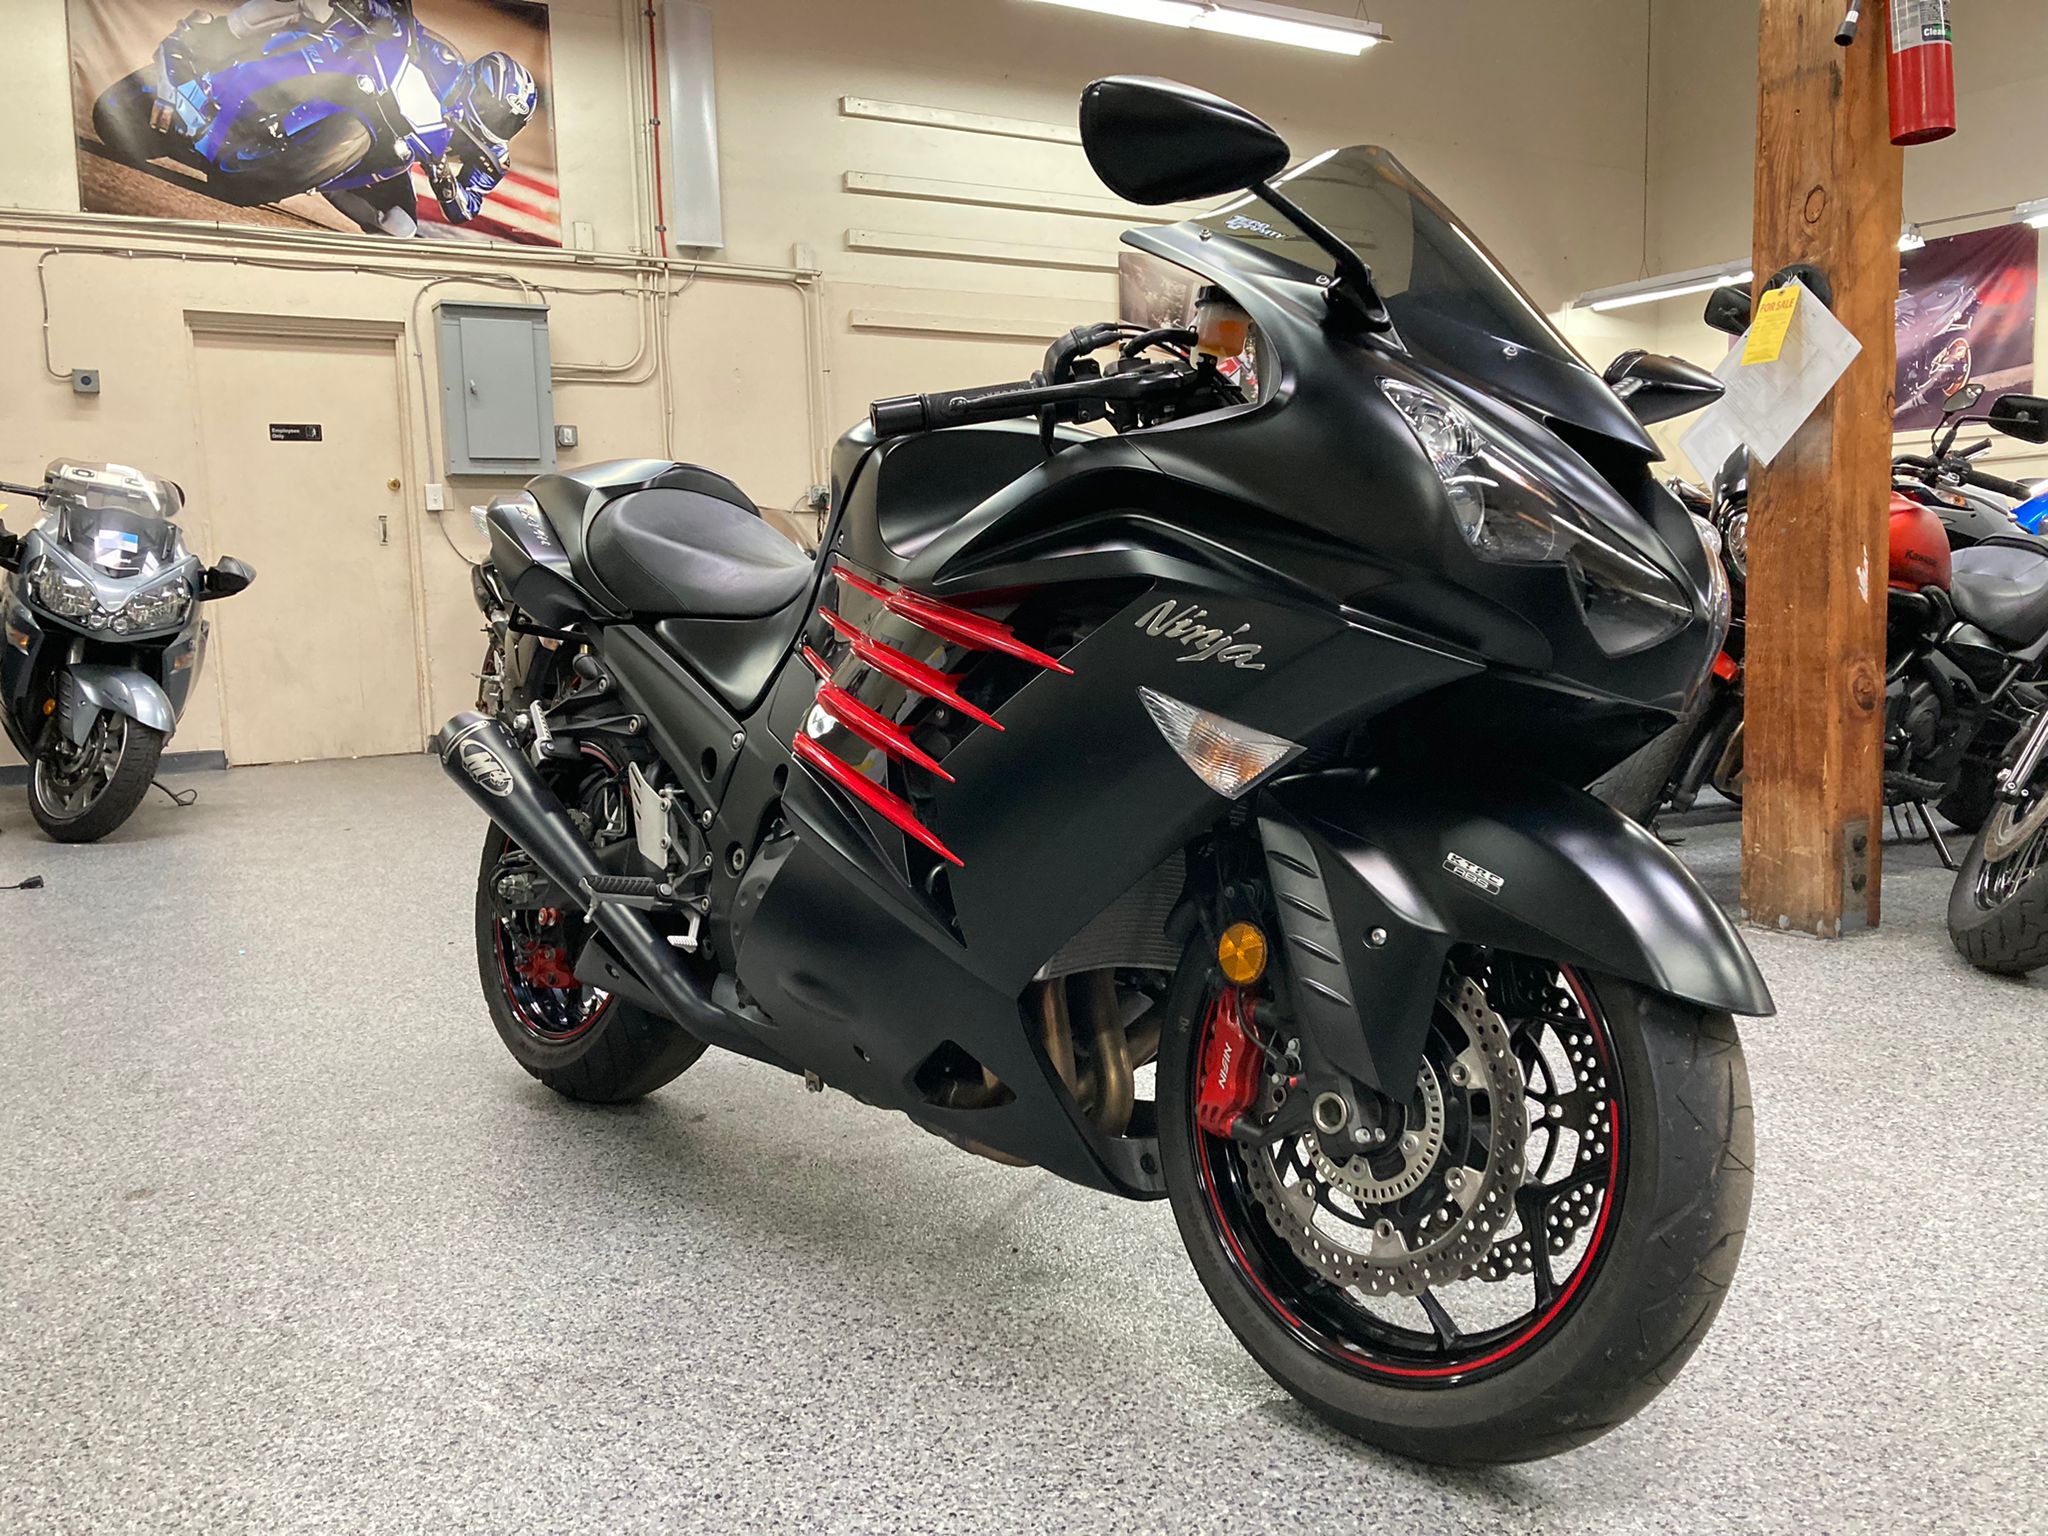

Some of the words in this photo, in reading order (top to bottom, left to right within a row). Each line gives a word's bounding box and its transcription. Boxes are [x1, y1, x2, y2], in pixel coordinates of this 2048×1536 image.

[1760, 303, 1776, 313] FOR
[1775, 297, 1796, 311] SALE
[1134, 599, 1266, 670] Ninja
[1450, 855, 1501, 884] KTRC
[1453, 866, 1489, 889] ABS
